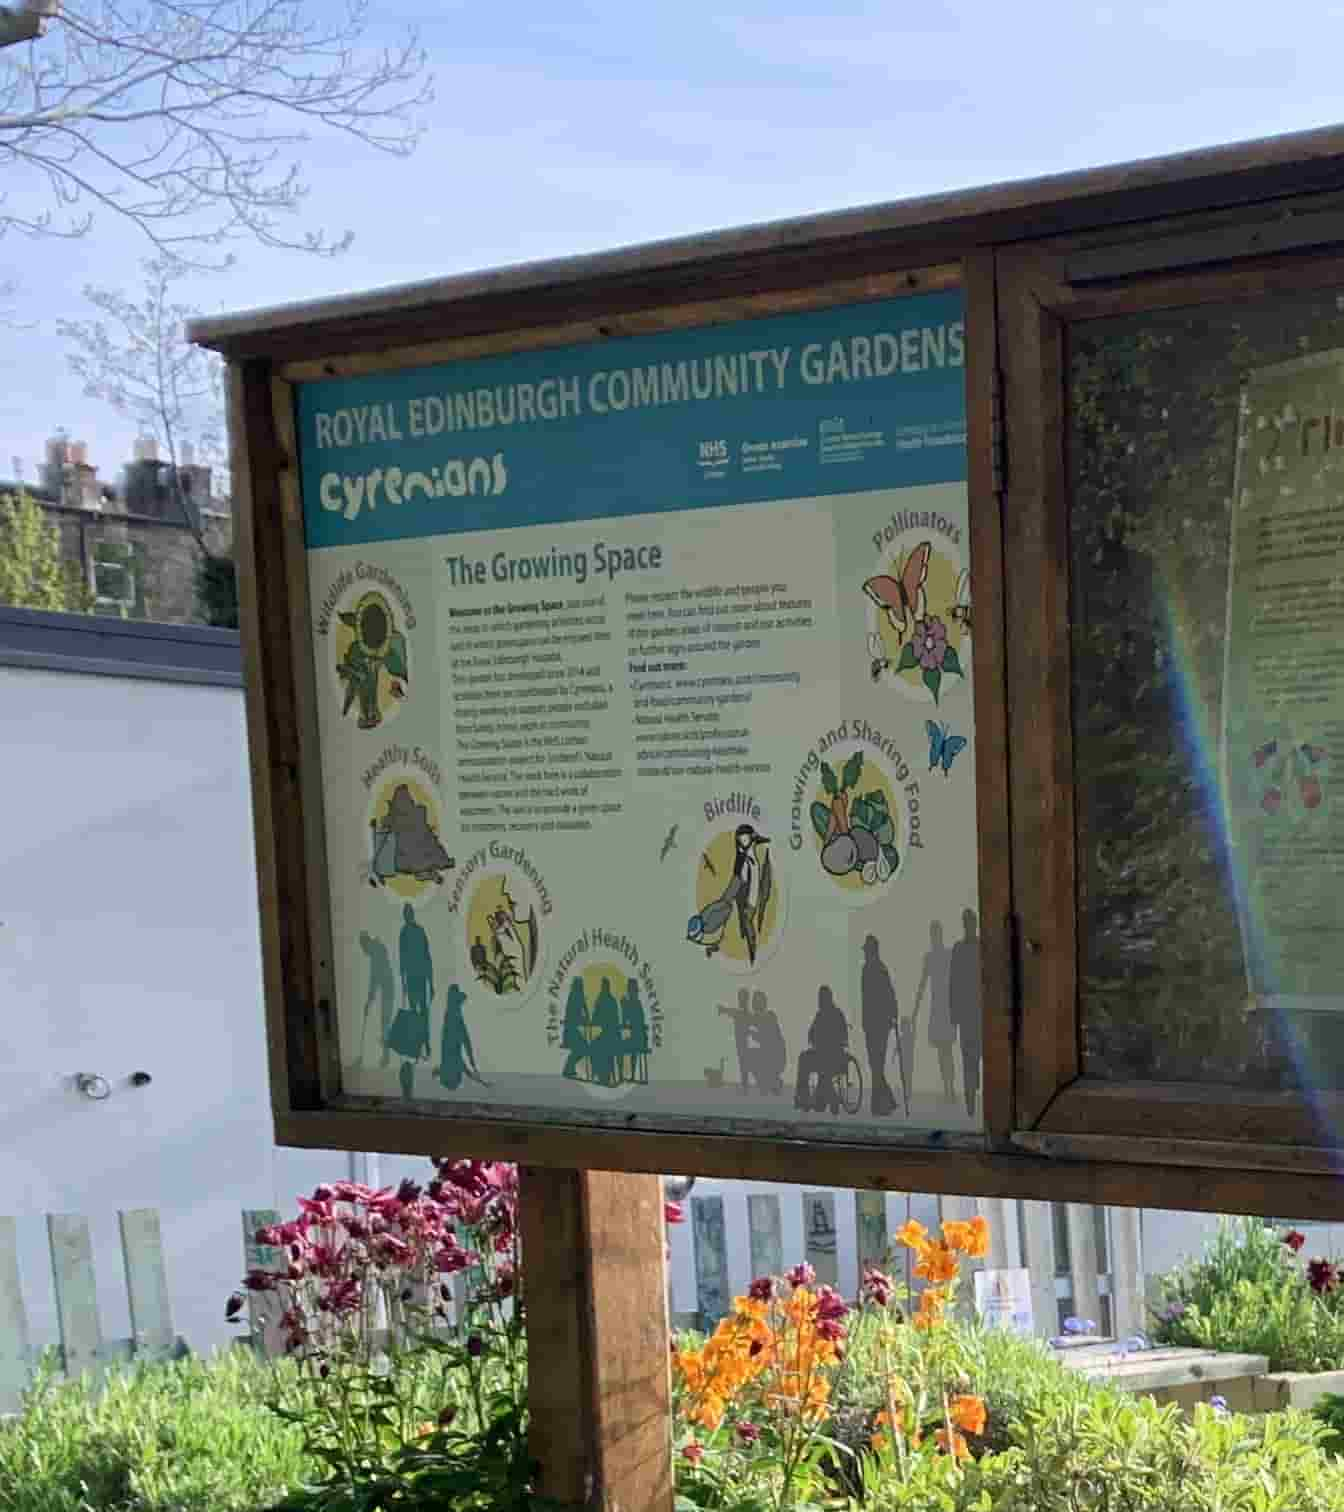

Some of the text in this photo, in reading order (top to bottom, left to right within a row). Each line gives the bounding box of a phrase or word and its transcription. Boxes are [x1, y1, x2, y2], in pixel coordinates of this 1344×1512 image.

[316, 322, 966, 449] ROYAL EDINBURGH COMMUNITY GARDENS
[699, 440, 728, 457] NHS
[871, 507, 960, 553] Pollinators
[446, 542, 662, 587] The Growing Space
[318, 560, 416, 638] Wildlife Gardening
[360, 744, 411, 791] Healthy
[789, 718, 924, 851] Growing and Sharing Food
[703, 790, 761, 822] Birdlife
[446, 839, 553, 916] Sensory Gardening
[545, 927, 665, 1049] The Natural Health Service
